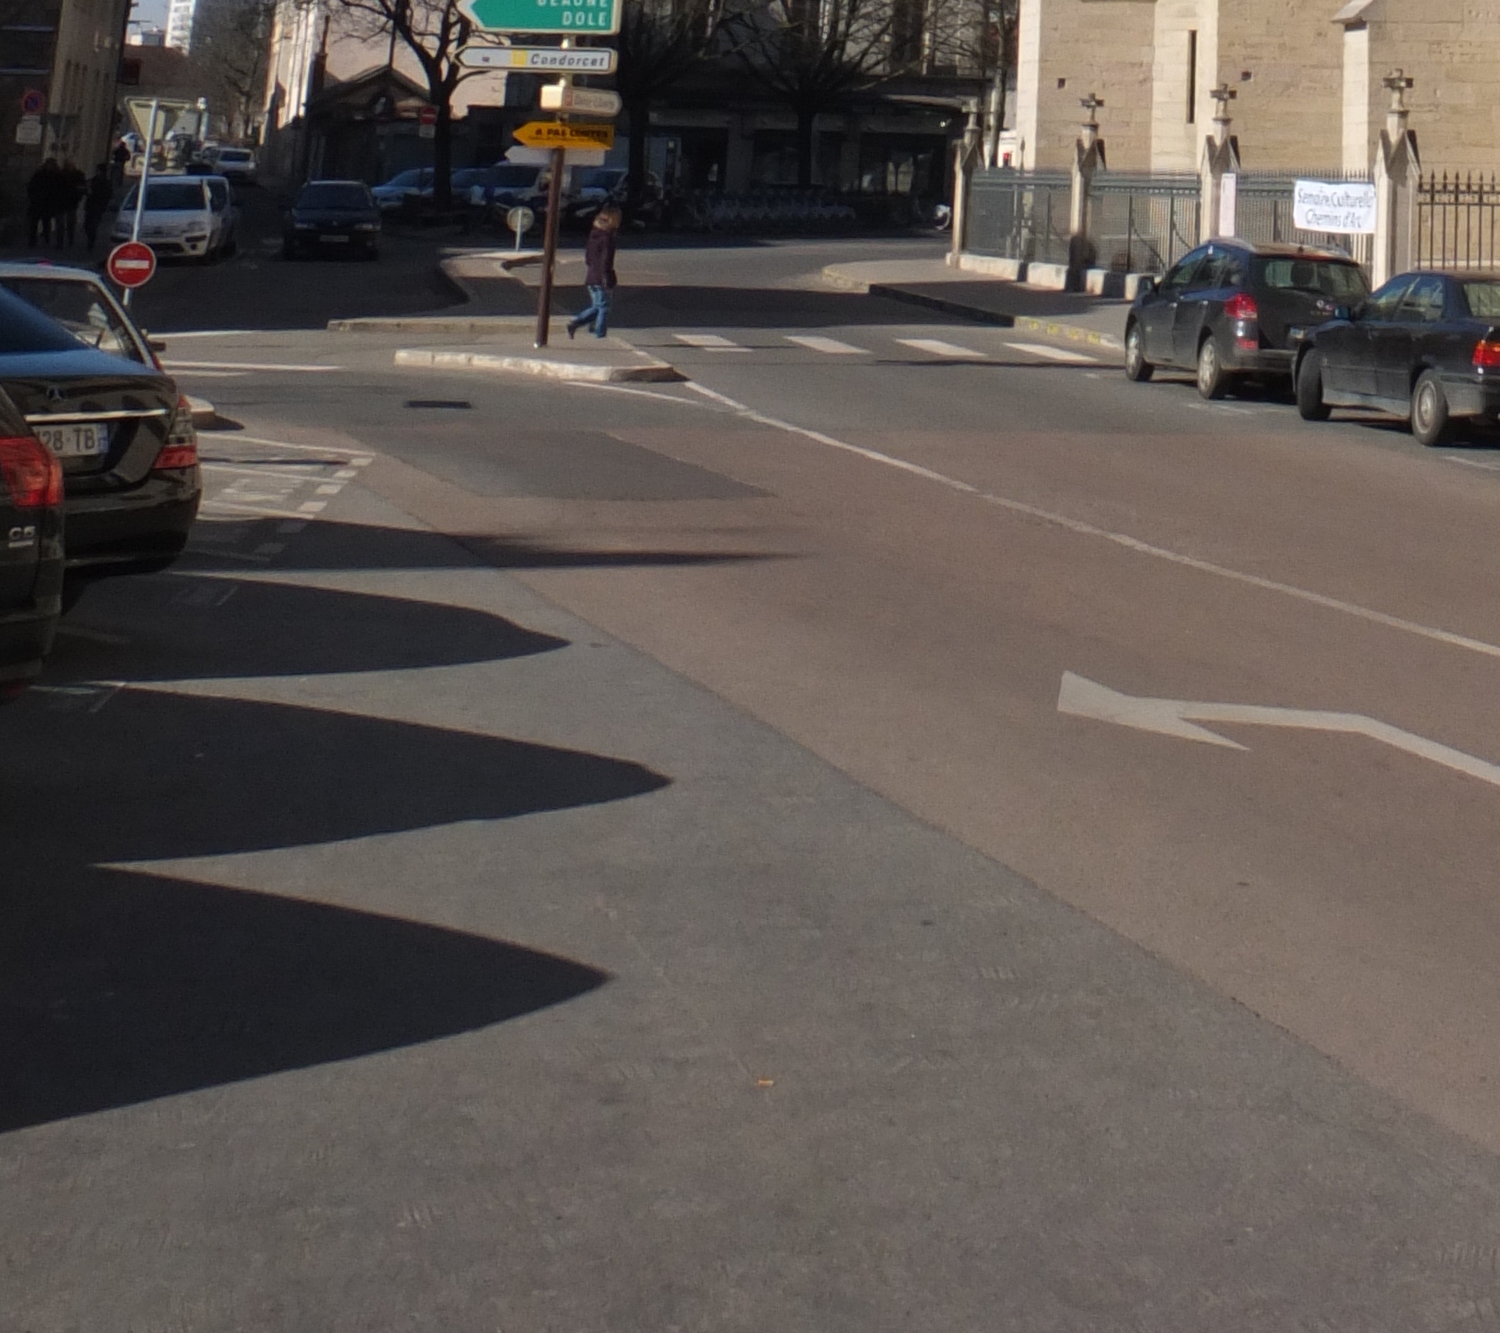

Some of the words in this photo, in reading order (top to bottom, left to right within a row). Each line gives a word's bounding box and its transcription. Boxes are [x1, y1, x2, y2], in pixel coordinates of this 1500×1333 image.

[562, 11, 607, 26] DOLE
[530, 53, 605, 67] Condorcet
[37, 427, 95, 452] 28-TB
